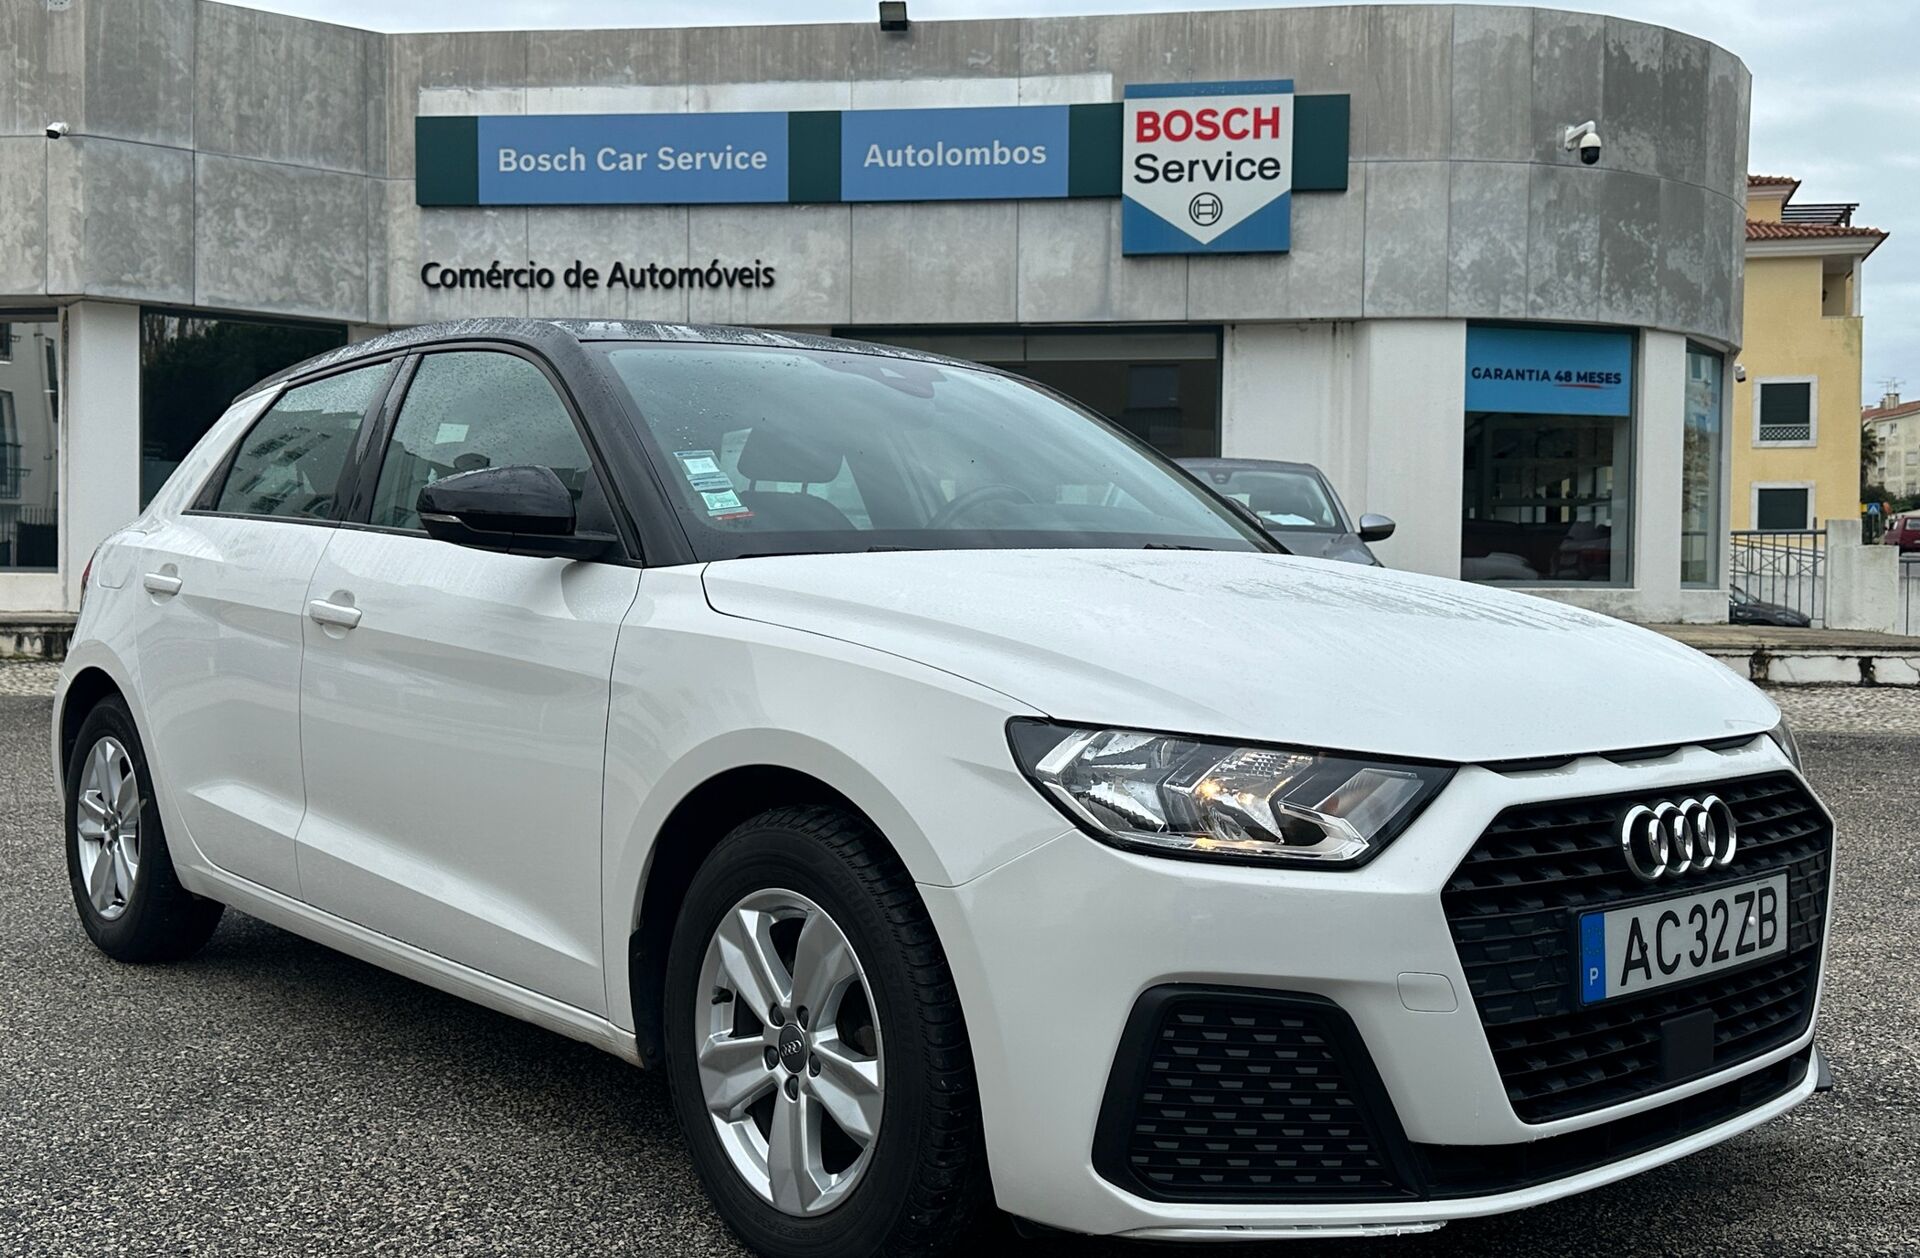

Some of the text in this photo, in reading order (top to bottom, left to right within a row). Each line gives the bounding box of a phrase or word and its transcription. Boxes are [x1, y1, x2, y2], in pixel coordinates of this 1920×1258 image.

[1136, 106, 1280, 143] BOSCH
[498, 145, 768, 172] Bosch Car Service
[863, 140, 1047, 168] Autolombos
[1134, 151, 1280, 184] Service
[421, 259, 776, 289] Comércio de Automóveis
[1471, 366, 1622, 385] GARANTIA 48 MESES
[1589, 967, 1599, 986] P
